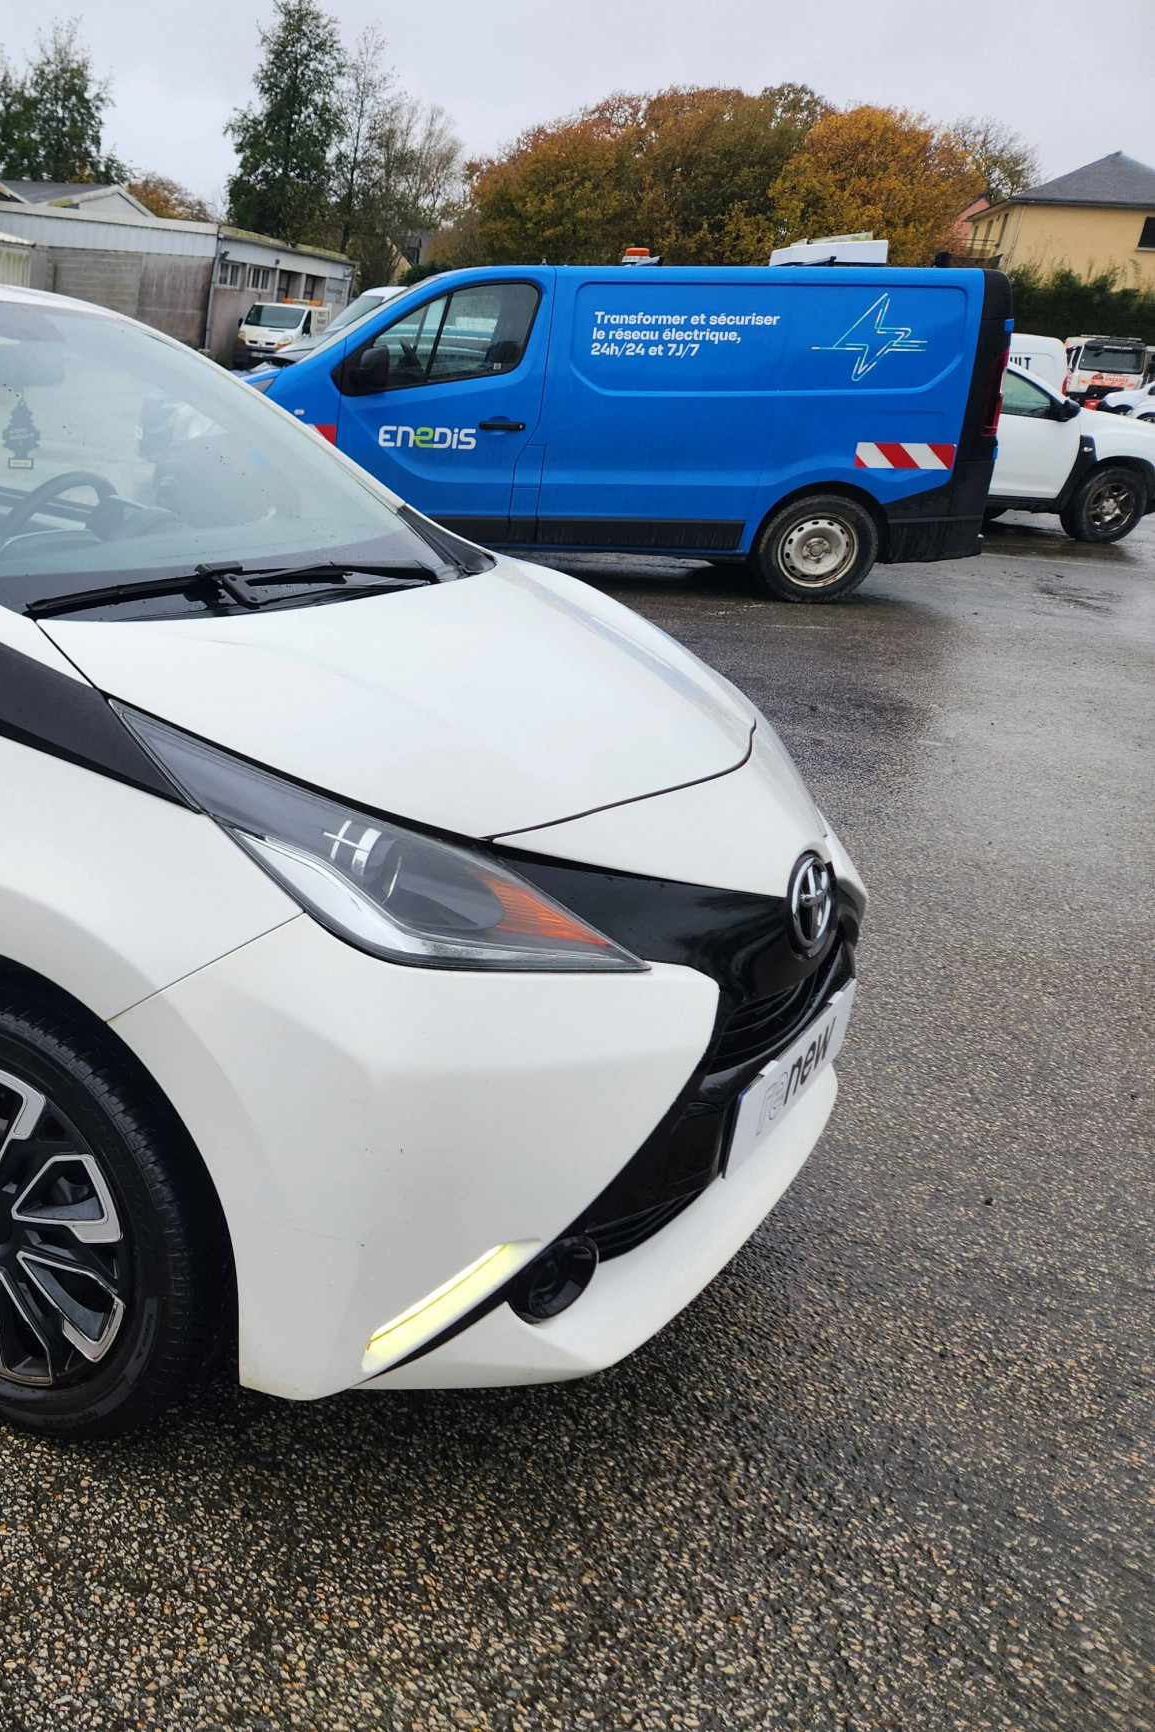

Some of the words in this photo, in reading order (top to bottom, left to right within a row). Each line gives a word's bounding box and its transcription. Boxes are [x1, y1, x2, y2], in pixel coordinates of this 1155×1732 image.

[594, 311, 687, 325] Transformer
[690, 313, 705, 325] et
[709, 312, 780, 326] sécuriser
[592, 327, 606, 340] le
[609, 328, 659, 340] réseau
[662, 328, 741, 344] électrique,
[591, 342, 645, 357] 24h/24
[648, 344, 664, 356] et
[667, 343, 700, 359] 7J/7
[755, 1016, 837, 1136] renew
